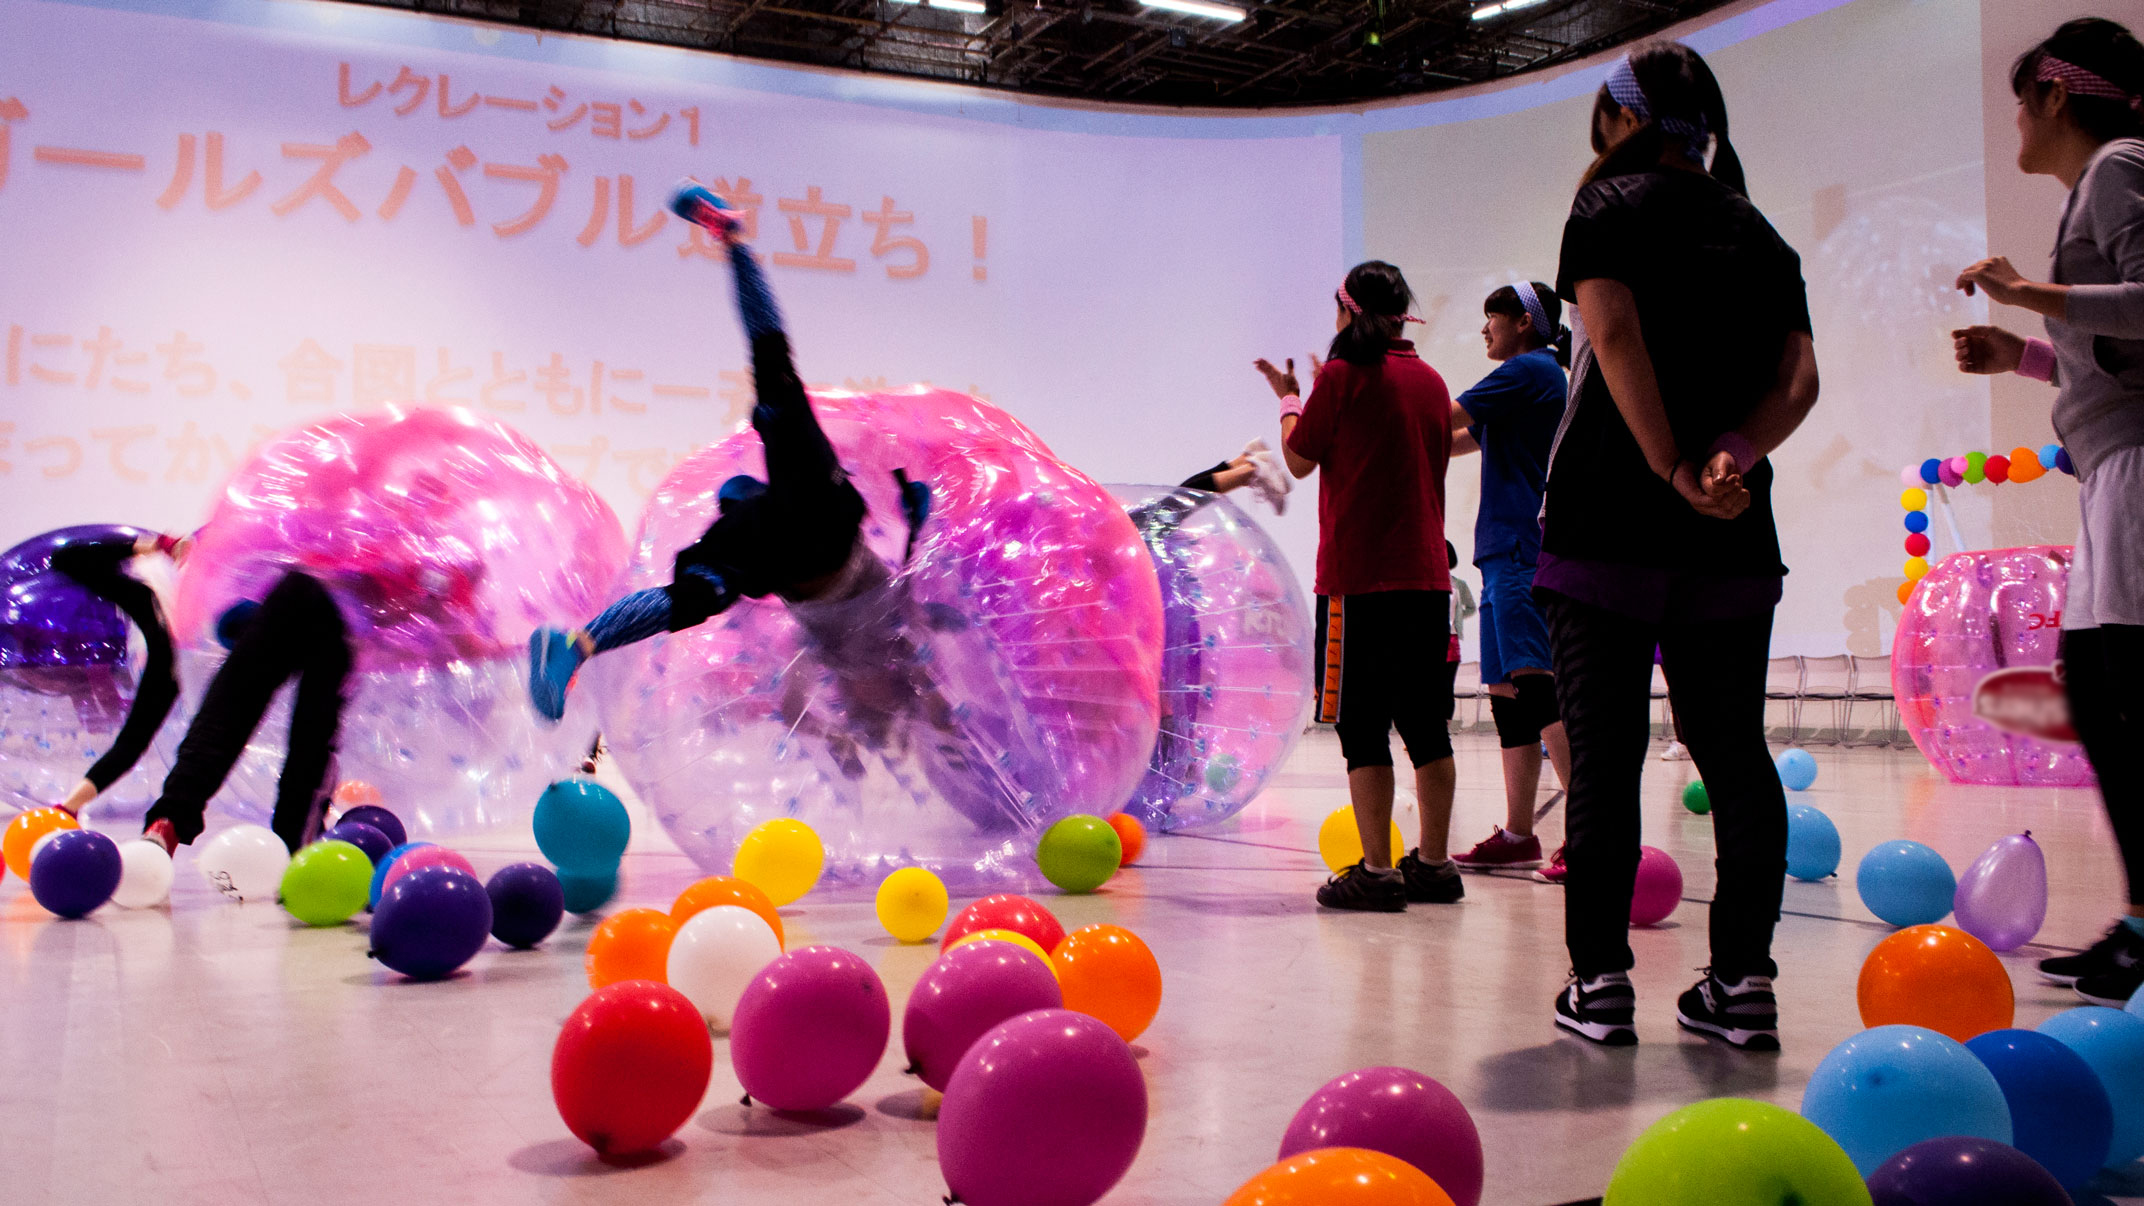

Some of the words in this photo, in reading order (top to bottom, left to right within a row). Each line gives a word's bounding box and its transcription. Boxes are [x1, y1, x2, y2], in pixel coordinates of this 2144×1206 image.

[338, 62, 699, 145] レクレーション1
